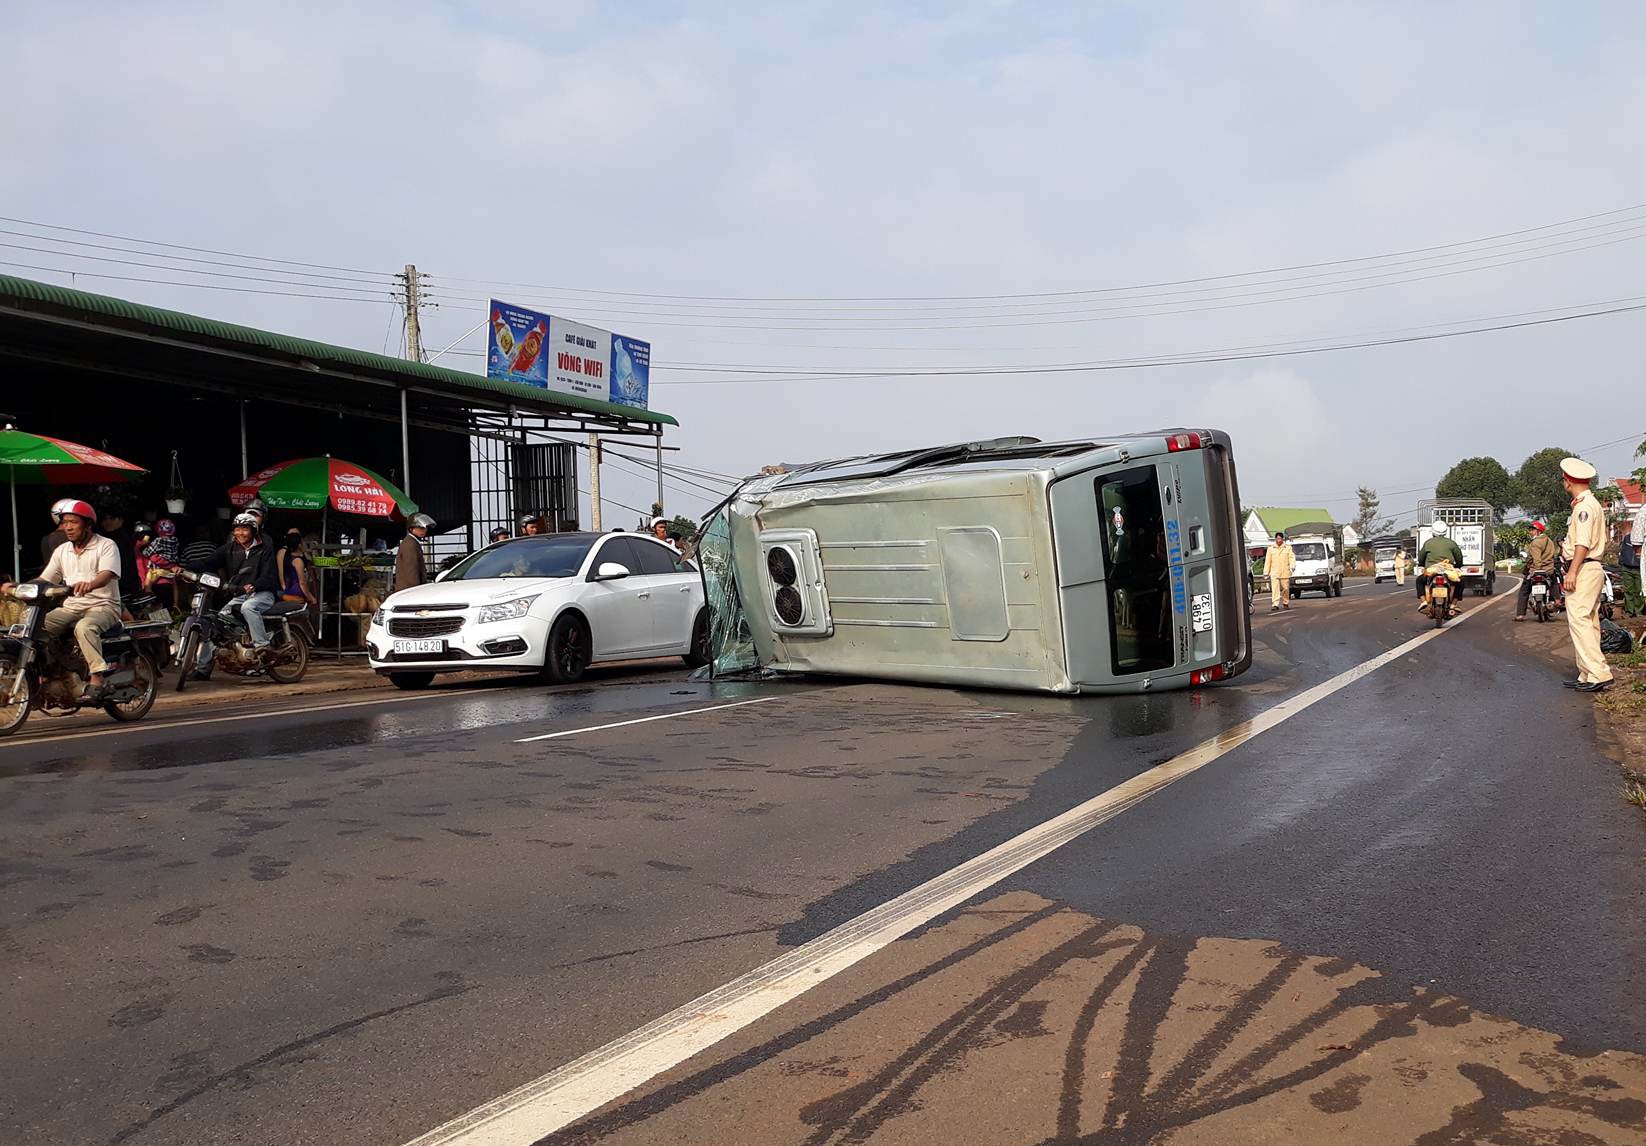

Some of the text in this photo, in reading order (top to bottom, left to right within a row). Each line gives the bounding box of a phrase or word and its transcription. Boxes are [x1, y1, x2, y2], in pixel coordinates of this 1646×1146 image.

[583, 358, 603, 378] WIFI
[334, 484, 362, 494] LONG
[1193, 603, 1202, 624] 49B
[1201, 594, 1212, 630] 011.32
